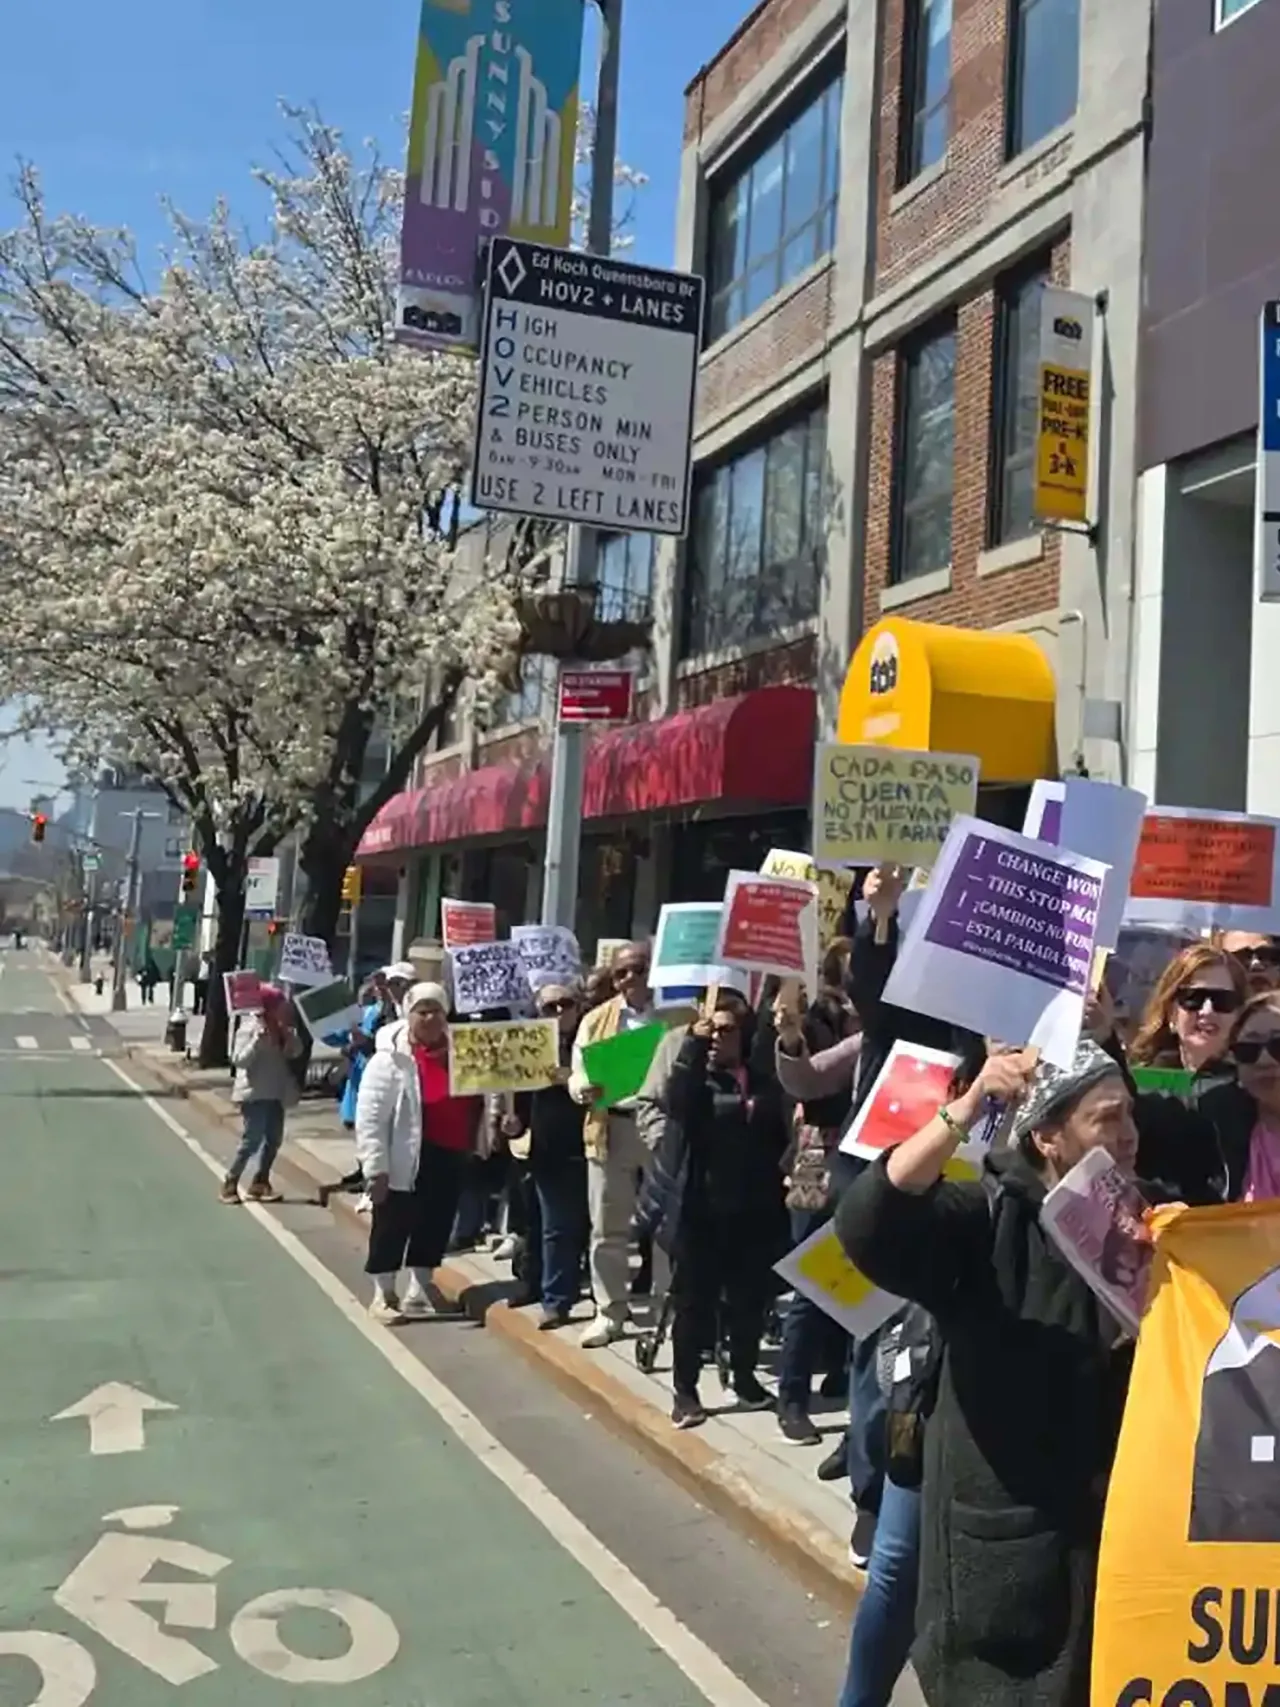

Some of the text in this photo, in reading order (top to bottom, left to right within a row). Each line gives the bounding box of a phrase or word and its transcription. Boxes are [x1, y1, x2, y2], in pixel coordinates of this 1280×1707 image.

[532, 252, 551, 269] Ed
[554, 257, 588, 278] Koch
[540, 279, 595, 307] HOV2
[620, 295, 686, 323] LANES
[1043, 370, 1089, 399] FREE
[488, 395, 652, 441] 2 PERSON MIN
[515, 428, 582, 455] BUSES
[593, 442, 641, 464] ONLY
[602, 467, 636, 484] MON
[651, 473, 677, 490] FRI
[480, 474, 679, 524] USE 2 LEFT LANES
[830, 756, 973, 785] CADA PASO
[839, 780, 949, 804] CUENTA
[824, 801, 850, 820] NO
[825, 822, 878, 842] ESTA
[998, 852, 1064, 887] CHANGE
[987, 874, 1027, 900] THIS
[1026, 889, 1072, 915] STOP
[966, 919, 1003, 943] ESTA
[1004, 933, 1061, 965] PARADA
